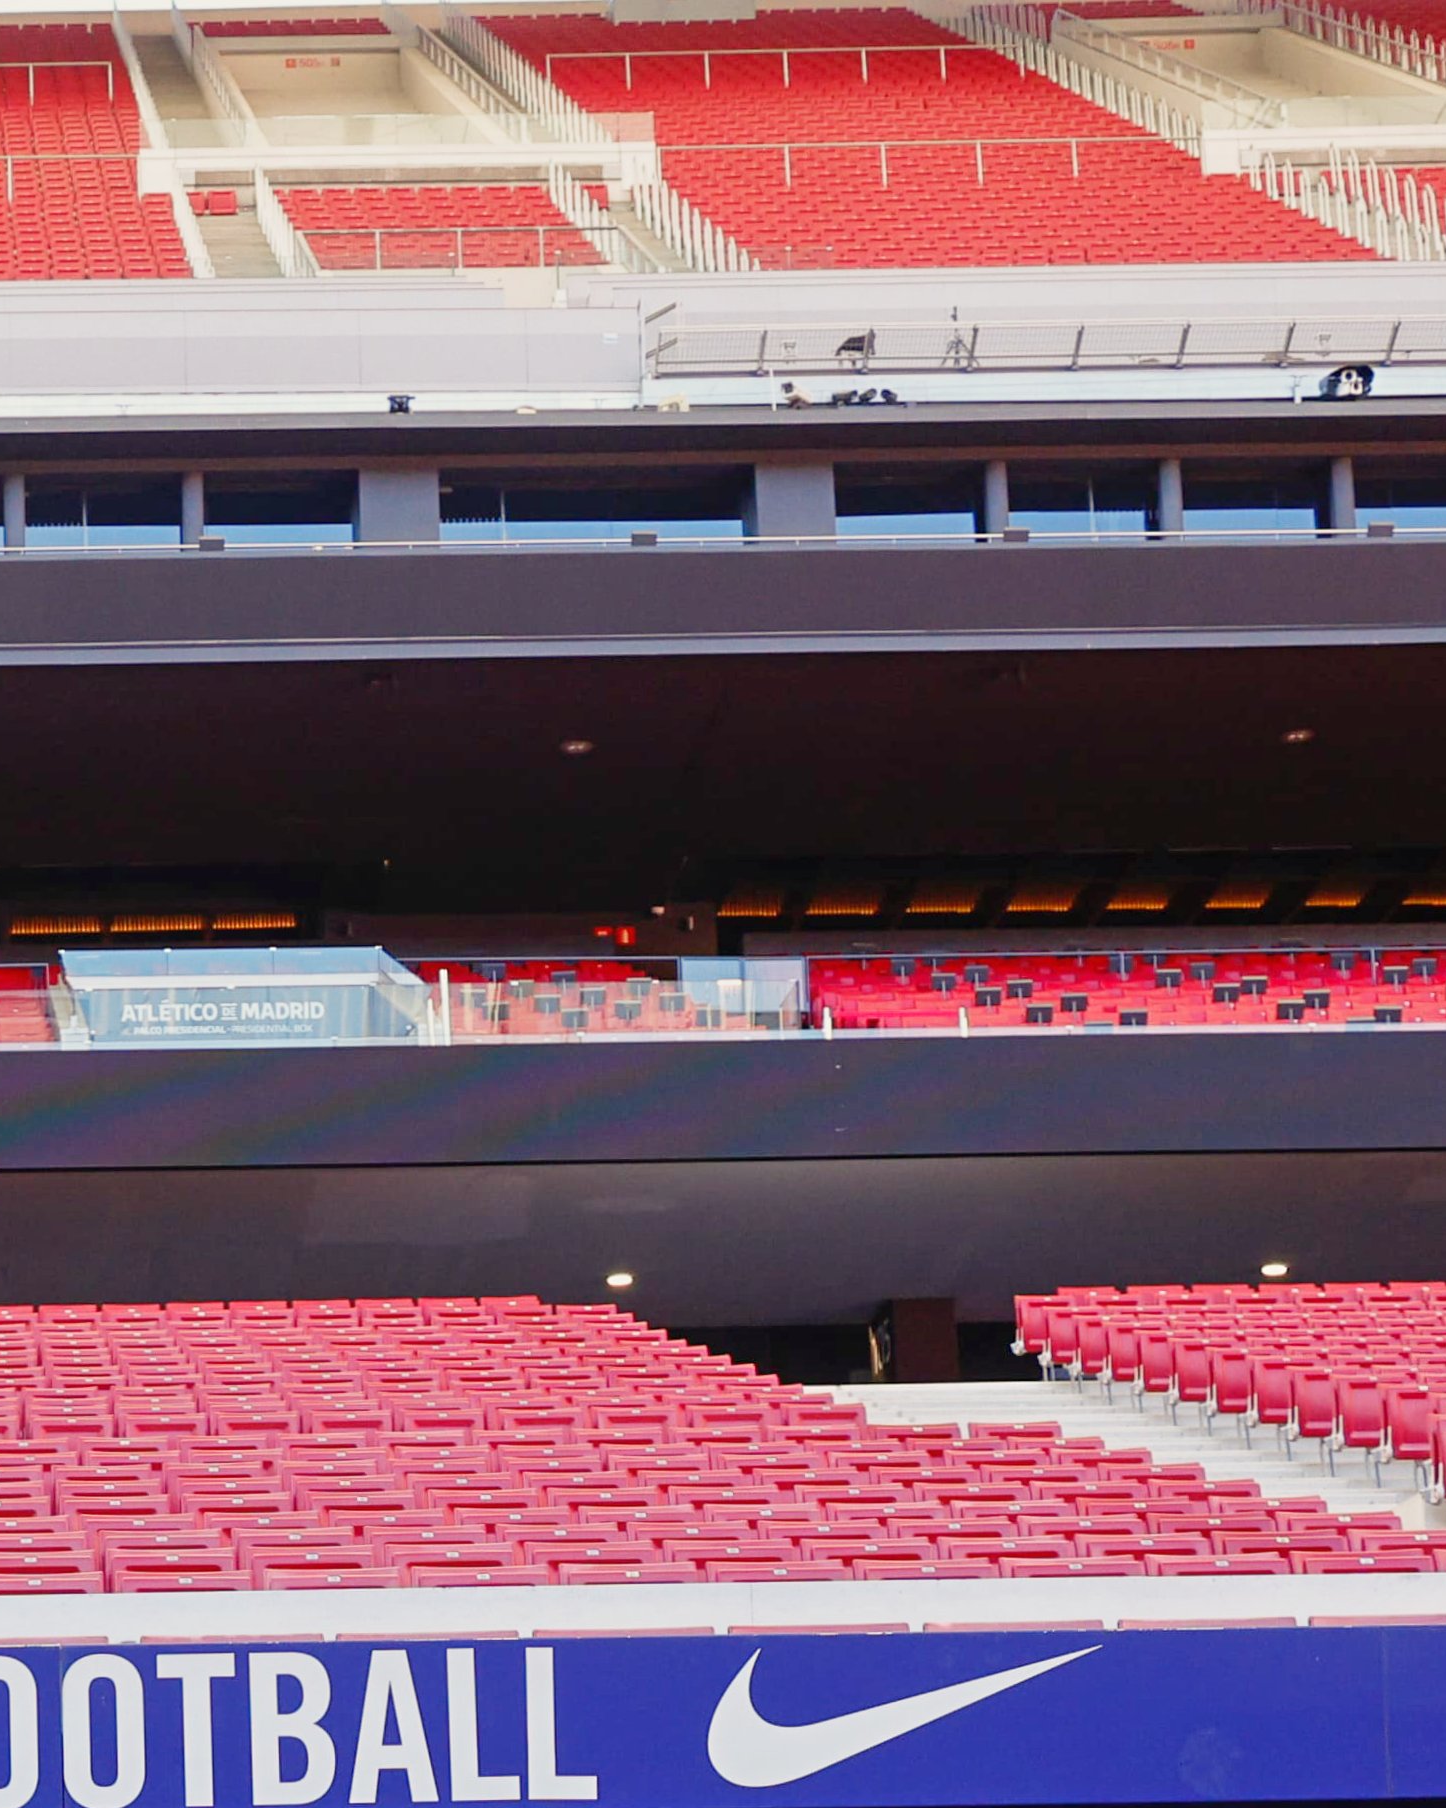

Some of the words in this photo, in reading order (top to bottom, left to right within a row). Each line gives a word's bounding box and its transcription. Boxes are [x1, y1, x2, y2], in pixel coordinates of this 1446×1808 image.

[121, 999, 218, 1022] ATLÉTICO
[221, 1004, 237, 1019] DE
[240, 1001, 324, 1020] MADRID
